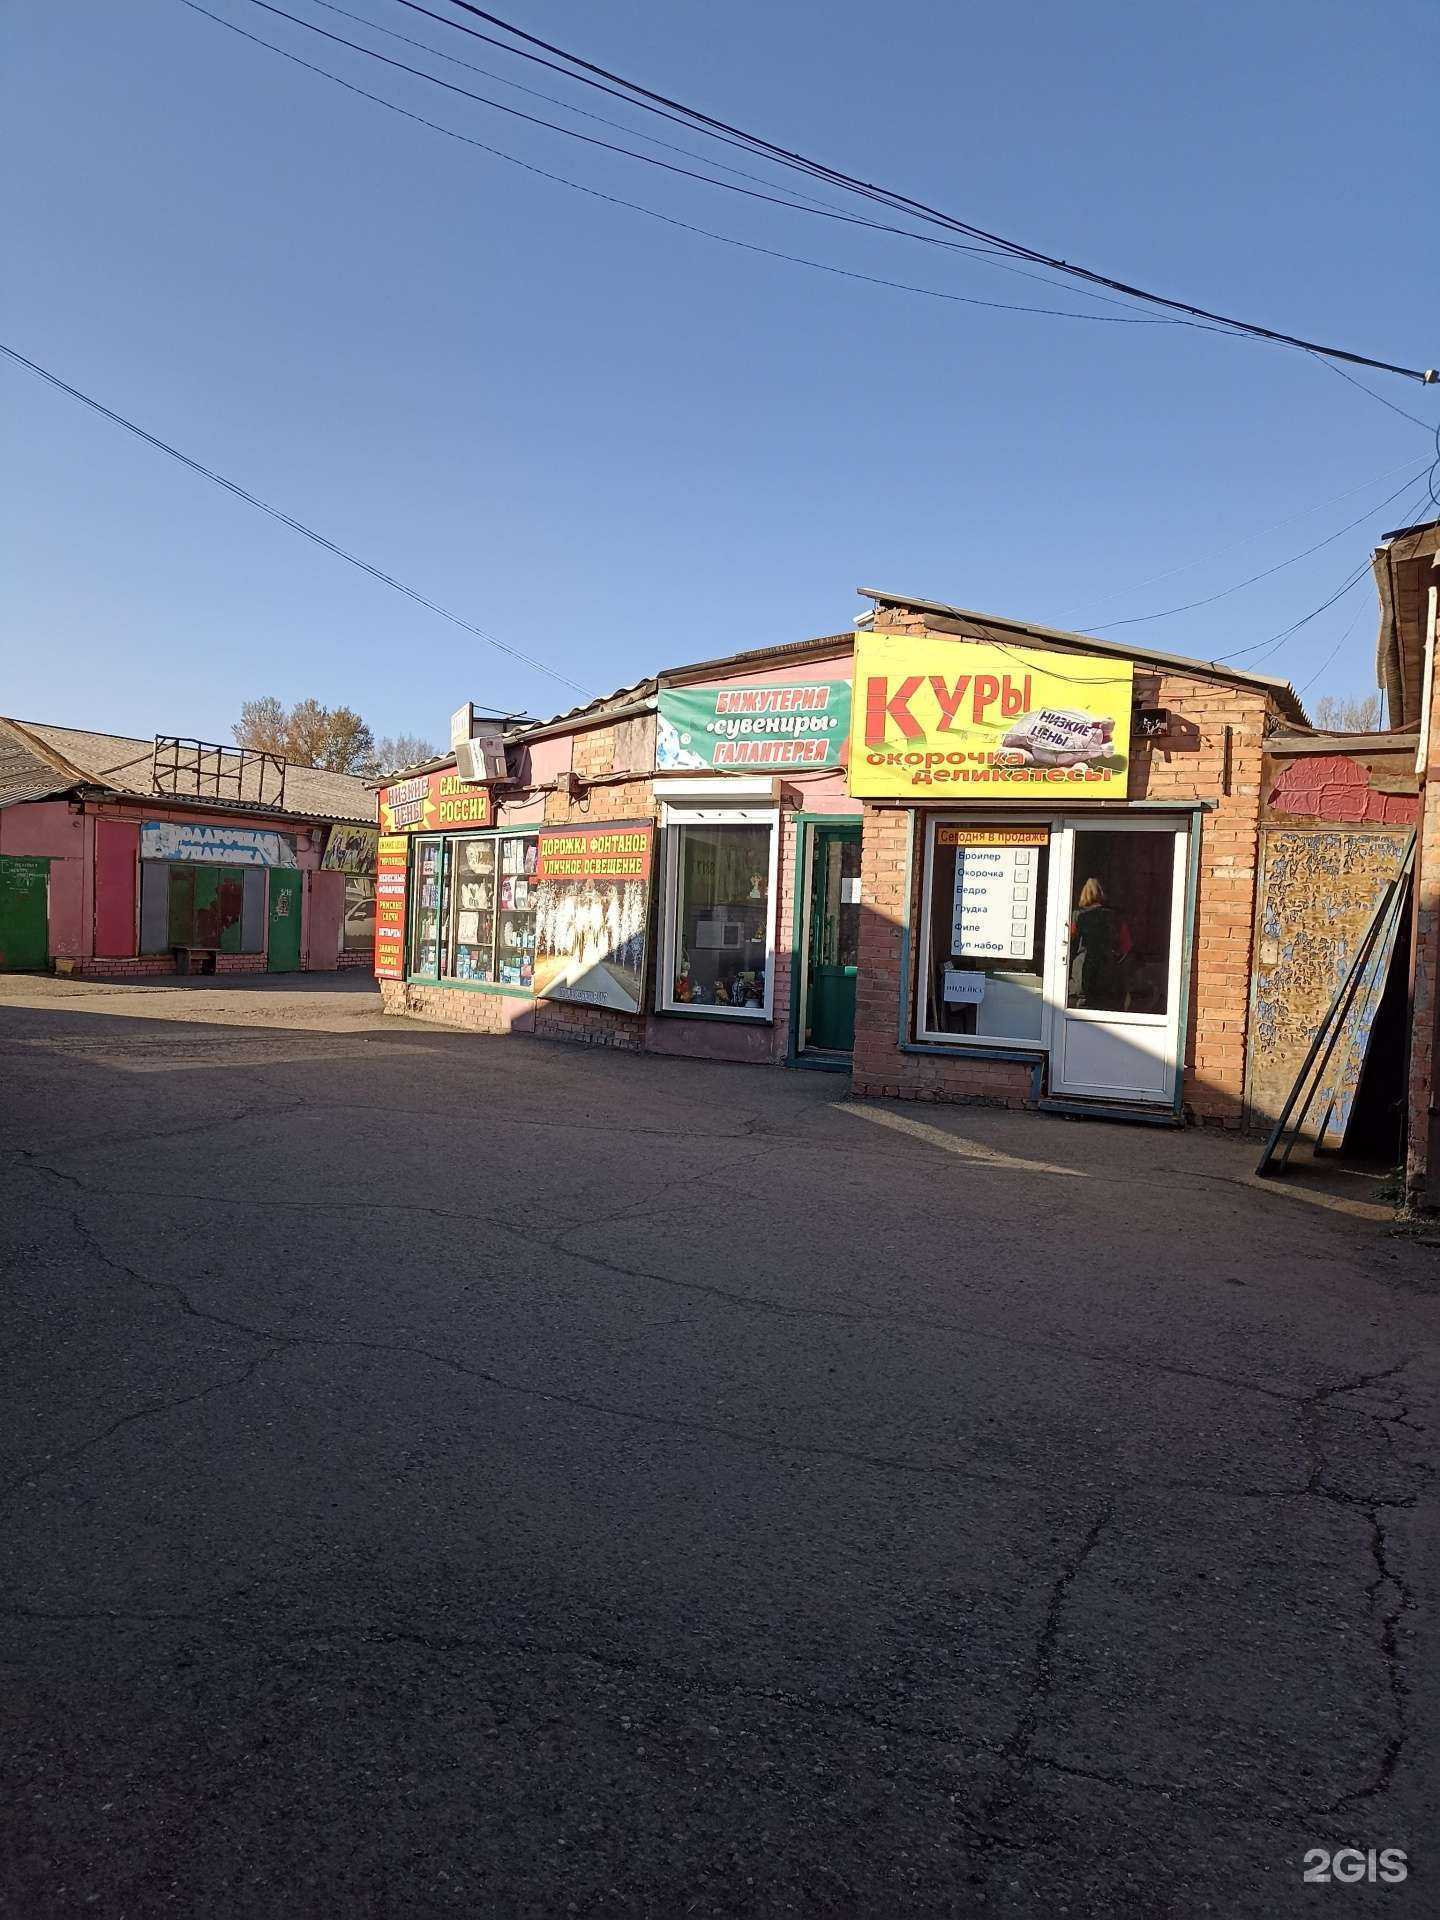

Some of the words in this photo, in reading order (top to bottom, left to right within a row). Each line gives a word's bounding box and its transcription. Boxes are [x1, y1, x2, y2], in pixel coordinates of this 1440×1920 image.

[715, 686, 830, 715] БИЖУТЕРИЯ
[865, 675, 1032, 746] КУРЫ
[1039, 711, 1095, 738] НИЗКИЕ
[1030, 725, 1069, 747] ЦЕНЫ
[713, 739, 829, 764] ГАЛАНТЕРЕЯ
[866, 751, 1025, 768] окорочка
[912, 767, 1113, 785] деликатесы
[387, 776, 430, 807] НИЗКИЕ
[394, 801, 424, 829] ЦЕНЫ
[440, 798, 486, 823] РОССИИ
[541, 836, 587, 857] ДОРОЖКА
[589, 833, 647, 853] ФОНТАНОВ
[940, 831, 986, 843] Сегодня
[989, 833, 996, 842] в
[1000, 832, 1046, 844] продаже
[543, 860, 582, 875] УЛИЧНОЕ
[584, 857, 643, 875] ОСВЕЩЕНИЕ
[957, 868, 1004, 878] Окорочка
[956, 885, 987, 896] Бедро
[955, 904, 988, 914] Грудка
[954, 922, 980, 932] Филе
[953, 940, 972, 951] Суп
[974, 942, 1004, 952] набор
